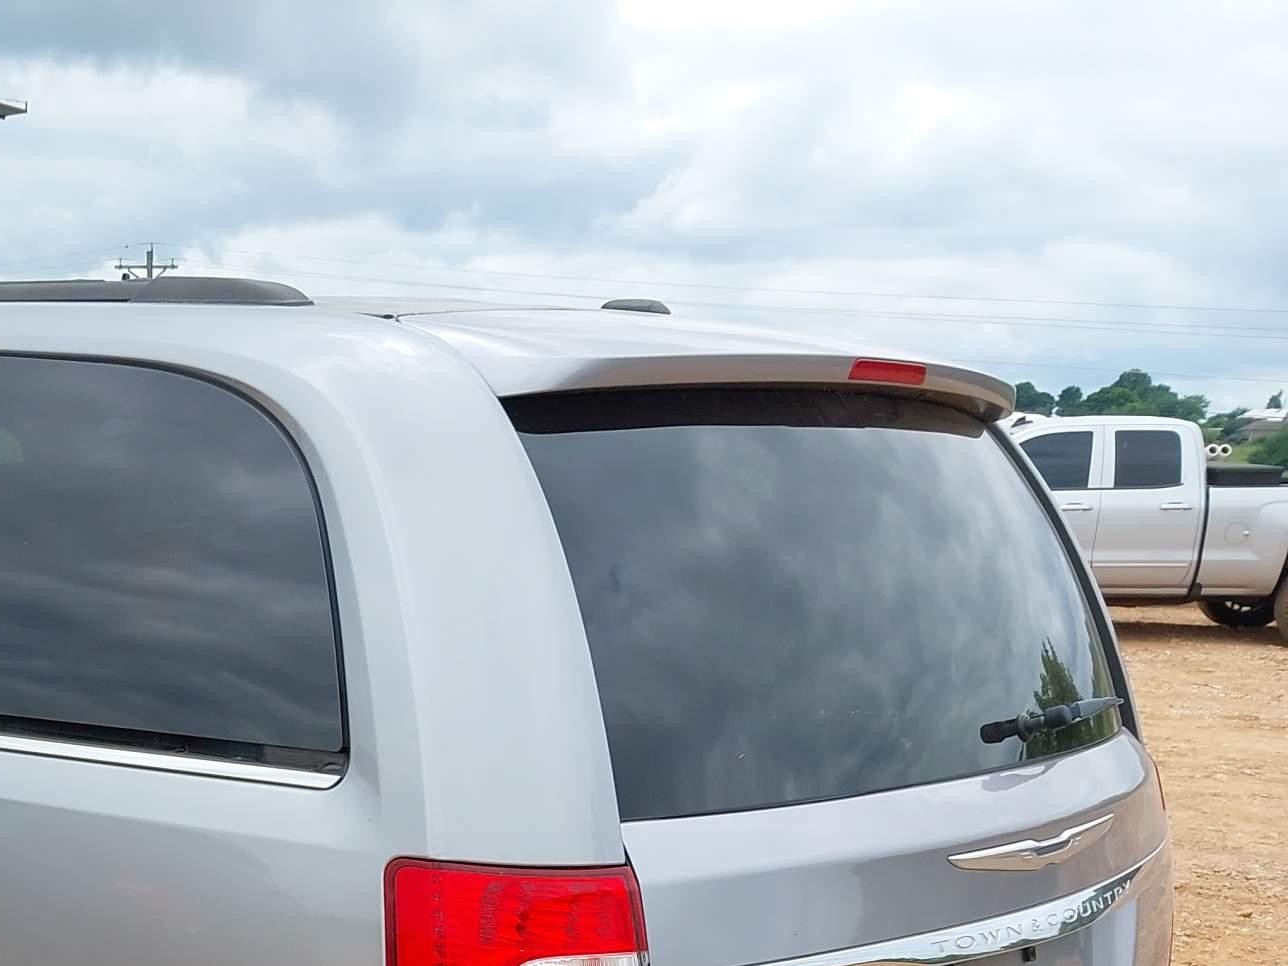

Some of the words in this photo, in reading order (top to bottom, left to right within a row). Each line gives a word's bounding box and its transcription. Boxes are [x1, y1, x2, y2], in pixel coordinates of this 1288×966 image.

[930, 922, 1023, 953] TOWN
[1031, 917, 1043, 933] &
[1047, 879, 1131, 928] COUNTRY
